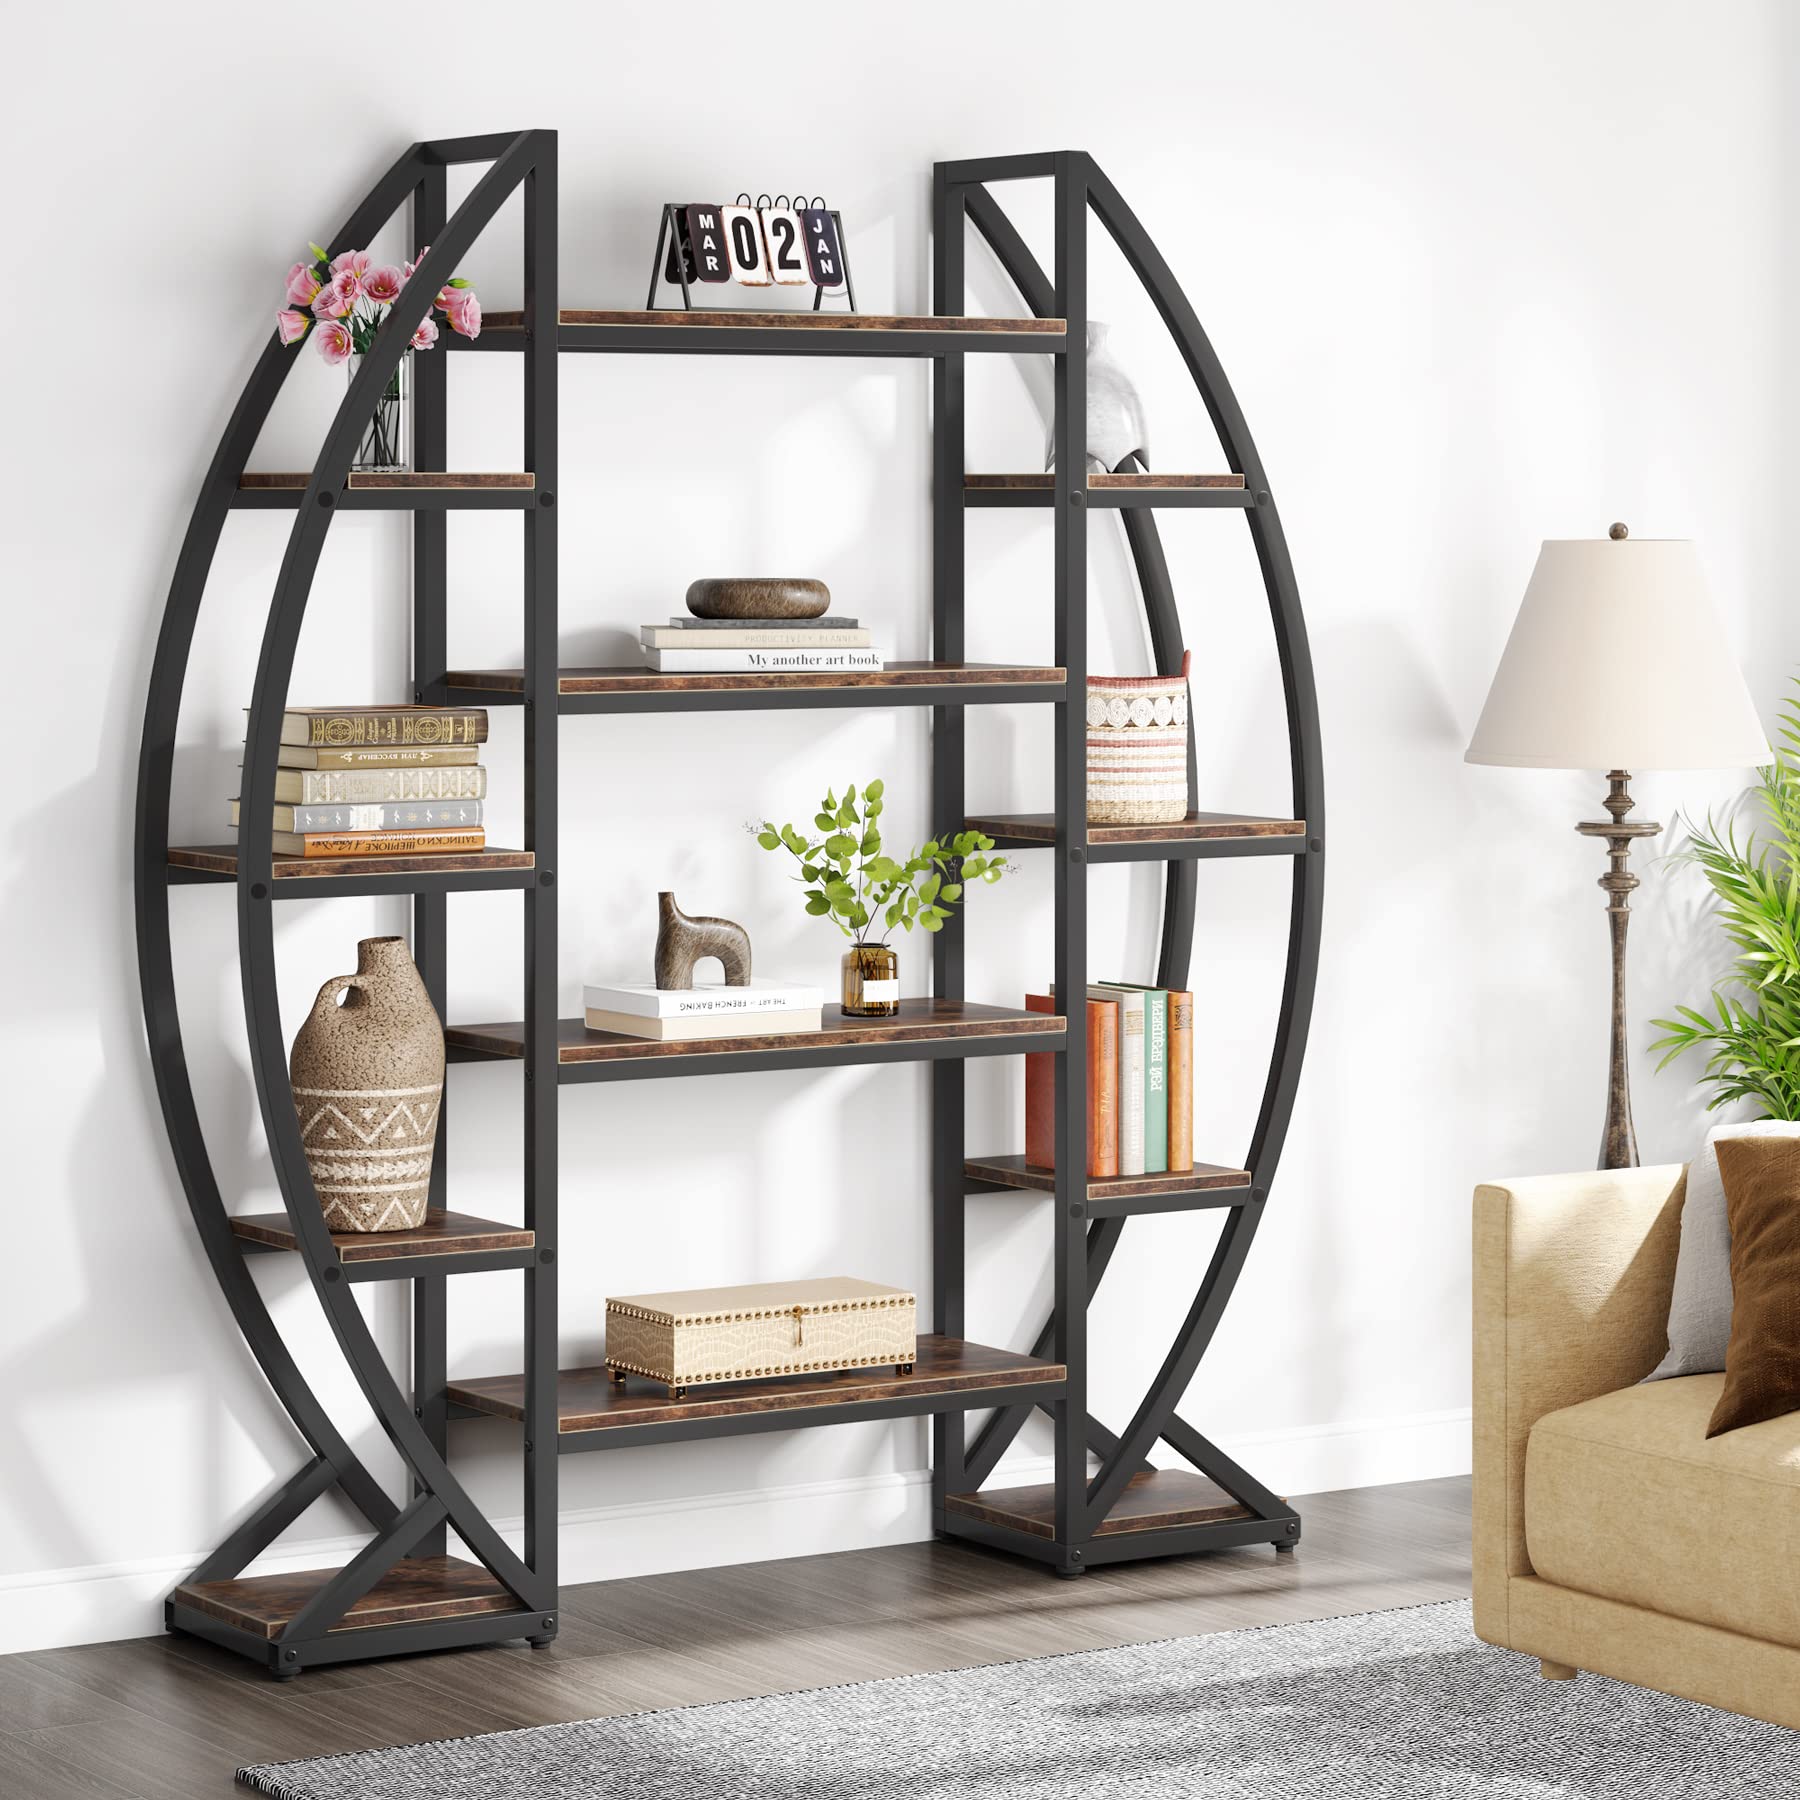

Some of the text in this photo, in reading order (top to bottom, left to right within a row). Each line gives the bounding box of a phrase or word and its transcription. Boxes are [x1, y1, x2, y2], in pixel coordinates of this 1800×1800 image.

[698, 214, 719, 271] MAR
[731, 215, 802, 271] 02
[813, 218, 834, 275] JAN
[748, 653, 879, 668] My another art book
[365, 842, 416, 852] ШЕРЛОКЕ
[427, 835, 478, 846] ЗАПИСКИ
[679, 1001, 713, 1011] BAKING
[715, 999, 747, 1008] FRENCH
